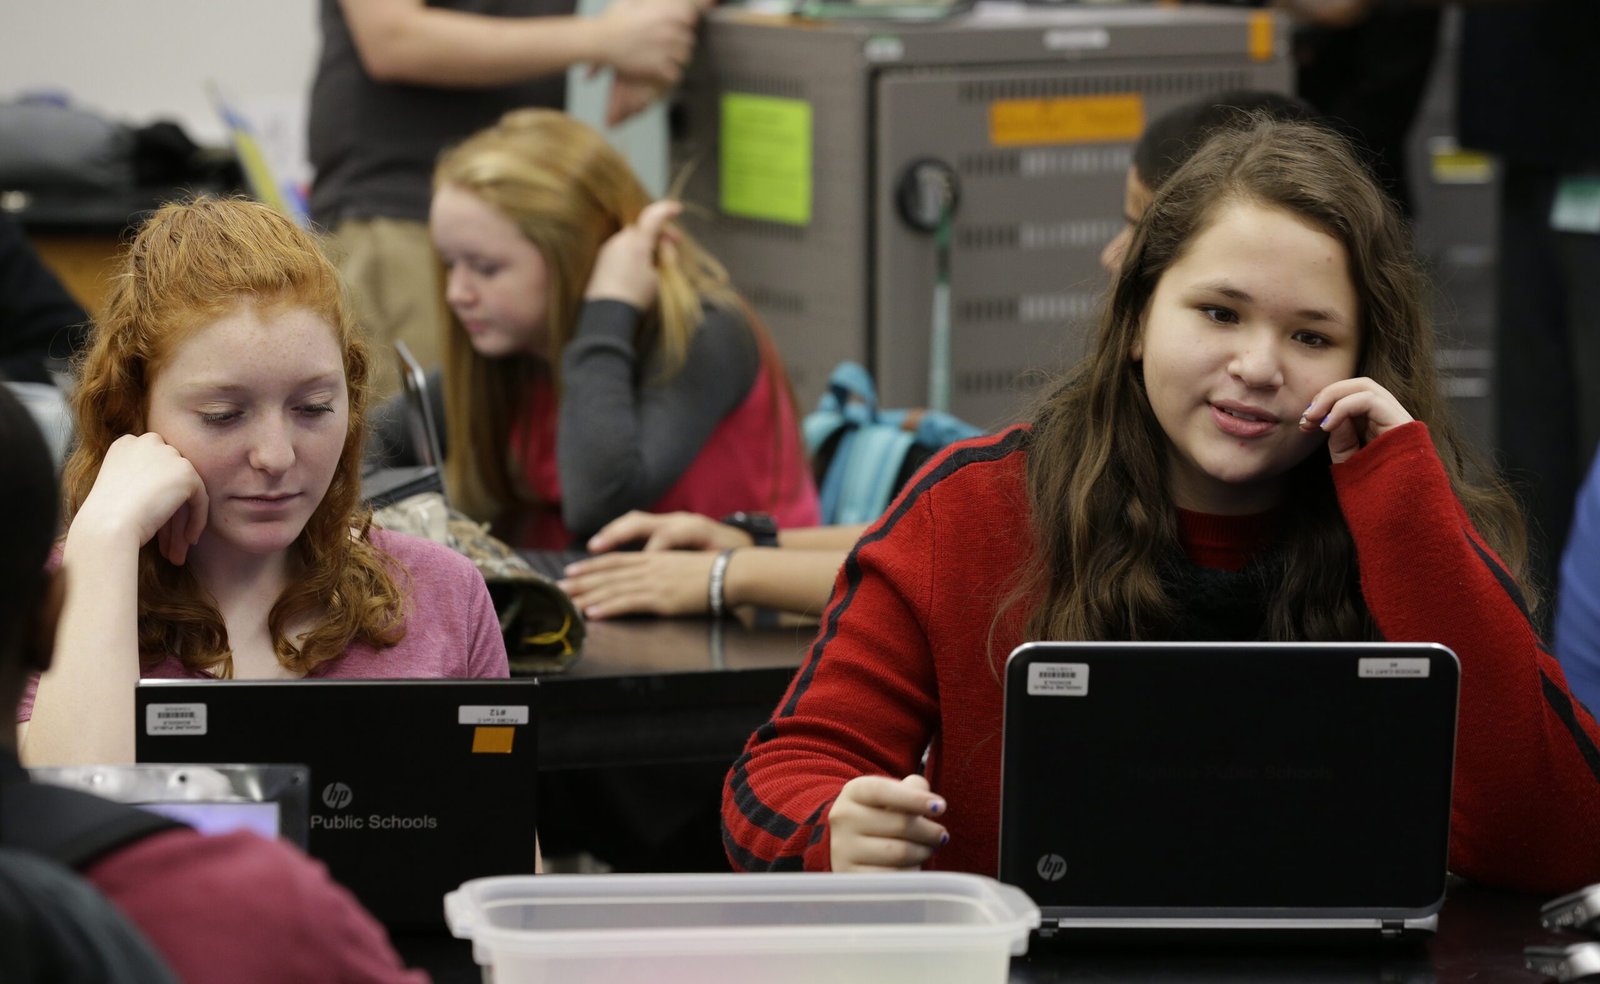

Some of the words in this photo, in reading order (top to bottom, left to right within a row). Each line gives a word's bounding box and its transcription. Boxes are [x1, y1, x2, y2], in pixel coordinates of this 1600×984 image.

[322, 782, 352, 809] hp
[310, 814, 364, 829] Public
[368, 814, 438, 829] Schools
[1037, 853, 1067, 881] hp
